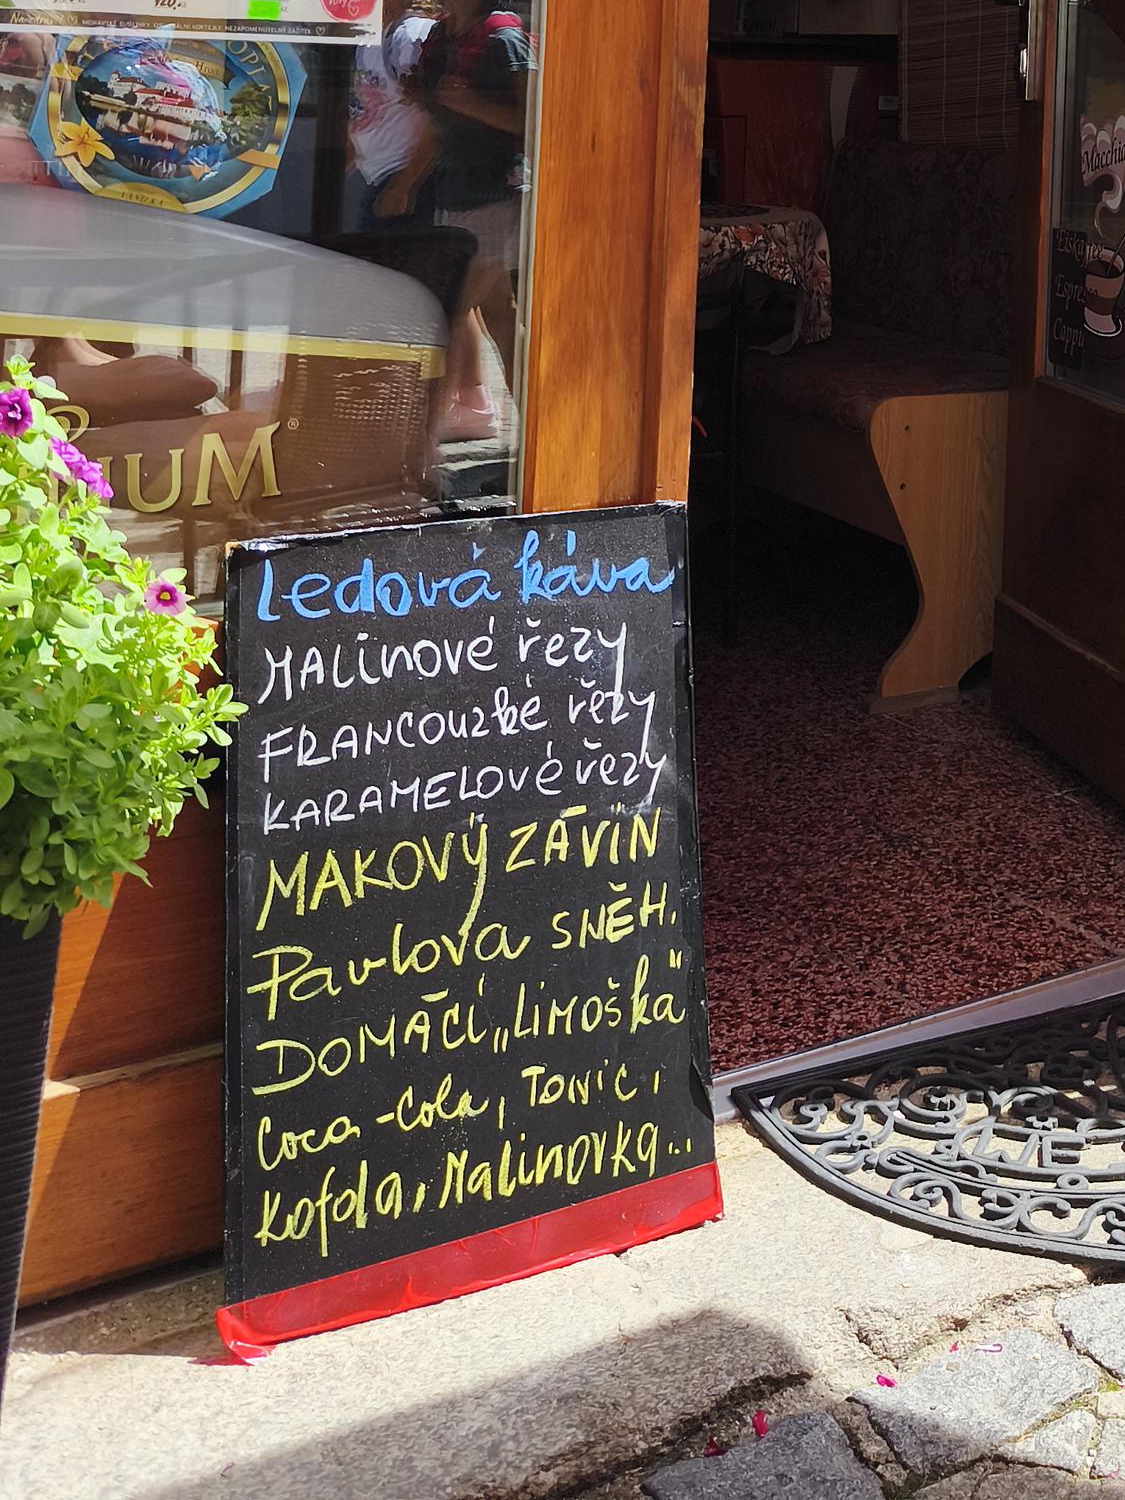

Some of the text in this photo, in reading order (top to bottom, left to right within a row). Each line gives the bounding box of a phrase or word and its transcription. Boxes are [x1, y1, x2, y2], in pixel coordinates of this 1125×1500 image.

[515, 529, 676, 605] káva
[518, 619, 628, 705] řezy
[568, 680, 656, 764] řezy
[575, 737, 668, 806] řezy
[247, 921, 532, 1021] Pavlova
